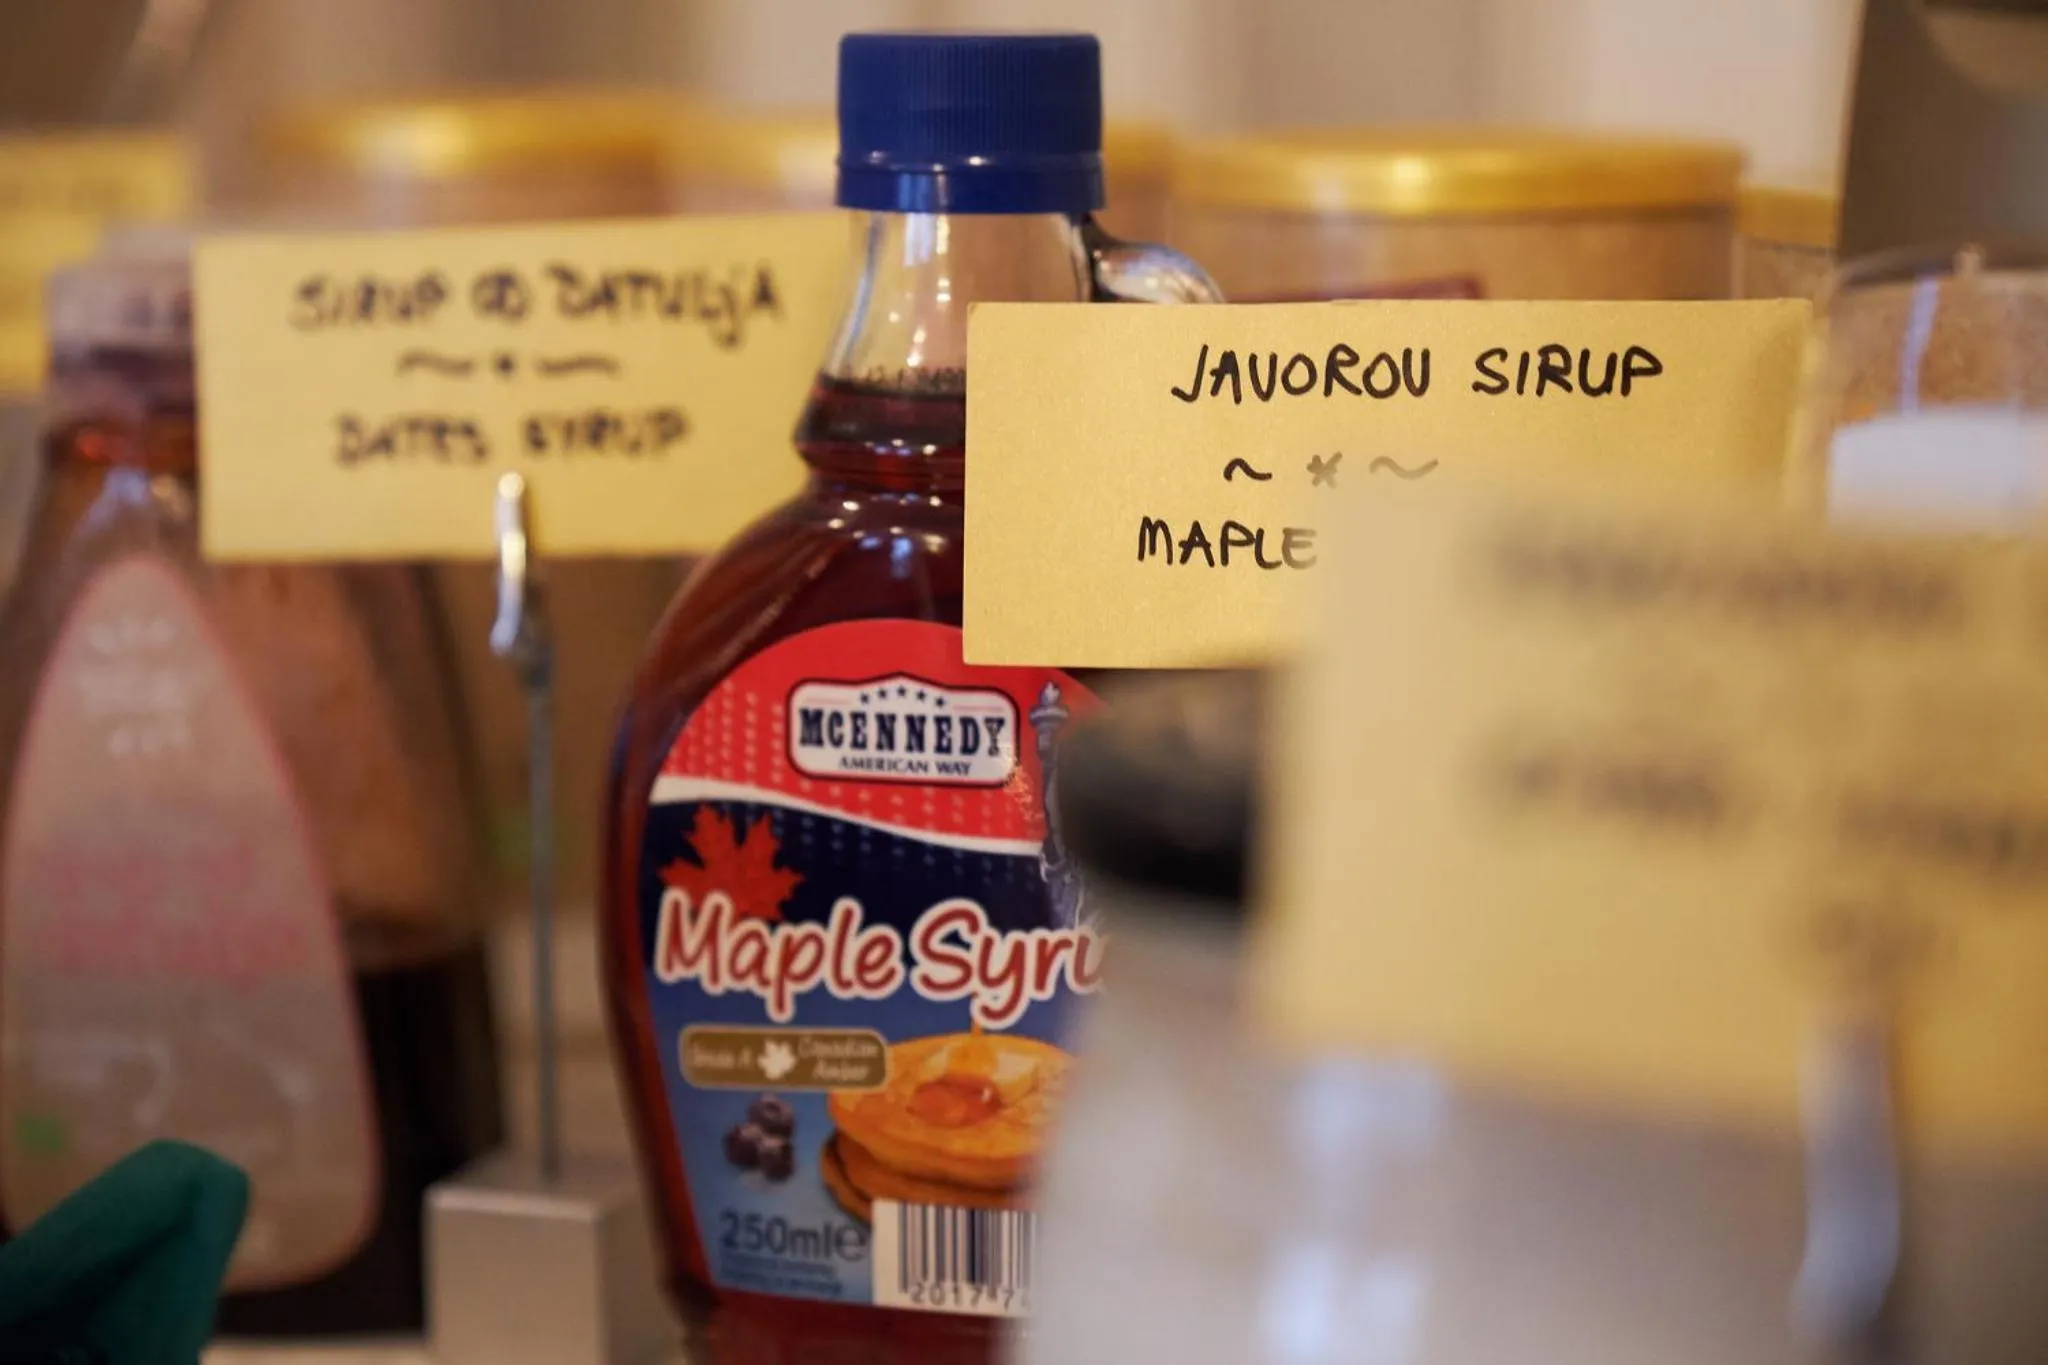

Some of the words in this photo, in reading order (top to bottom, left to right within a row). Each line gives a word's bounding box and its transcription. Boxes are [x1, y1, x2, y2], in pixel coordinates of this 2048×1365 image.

[292, 268, 448, 330] SIRUP
[1473, 344, 1664, 397] SIRUP
[1137, 516, 1317, 570] MAPLE
[799, 708, 1005, 757] MCENNEDY
[839, 755, 929, 774] AMERICAN
[935, 761, 971, 777] WAY
[655, 888, 905, 1023] Maple
[908, 899, 1108, 1029] Syru
